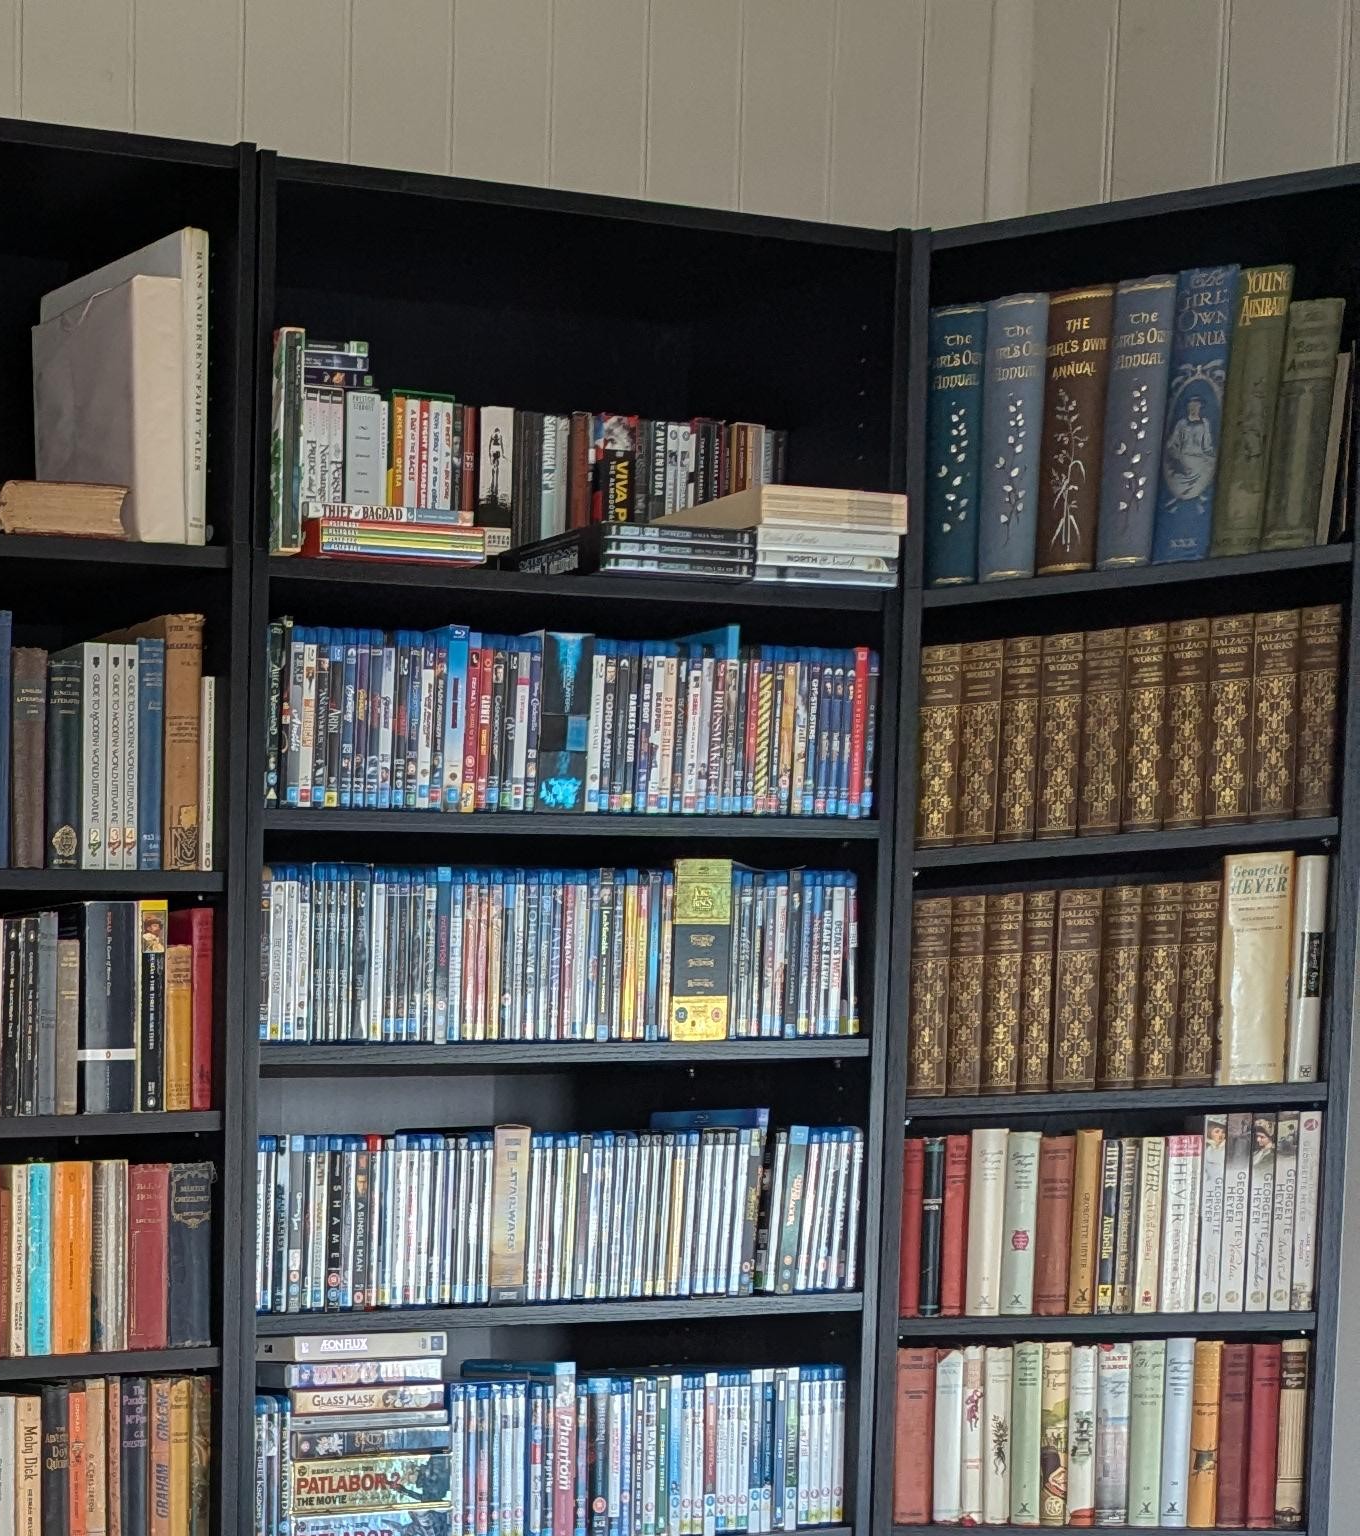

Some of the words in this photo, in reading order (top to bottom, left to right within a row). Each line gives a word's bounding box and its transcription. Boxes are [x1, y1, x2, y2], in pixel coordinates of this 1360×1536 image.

[1066, 317, 1090, 332] THE
[322, 505, 352, 519] THIEF
[362, 506, 403, 521] BAGDAD
[1232, 863, 1290, 878] Georgette
[1229, 877, 1288, 895] HEYER
[312, 1394, 344, 1407] GLASS
[347, 1395, 374, 1405] MASK
[22, 1425, 38, 1454] Moby
[24, 1456, 38, 1481] Dick
